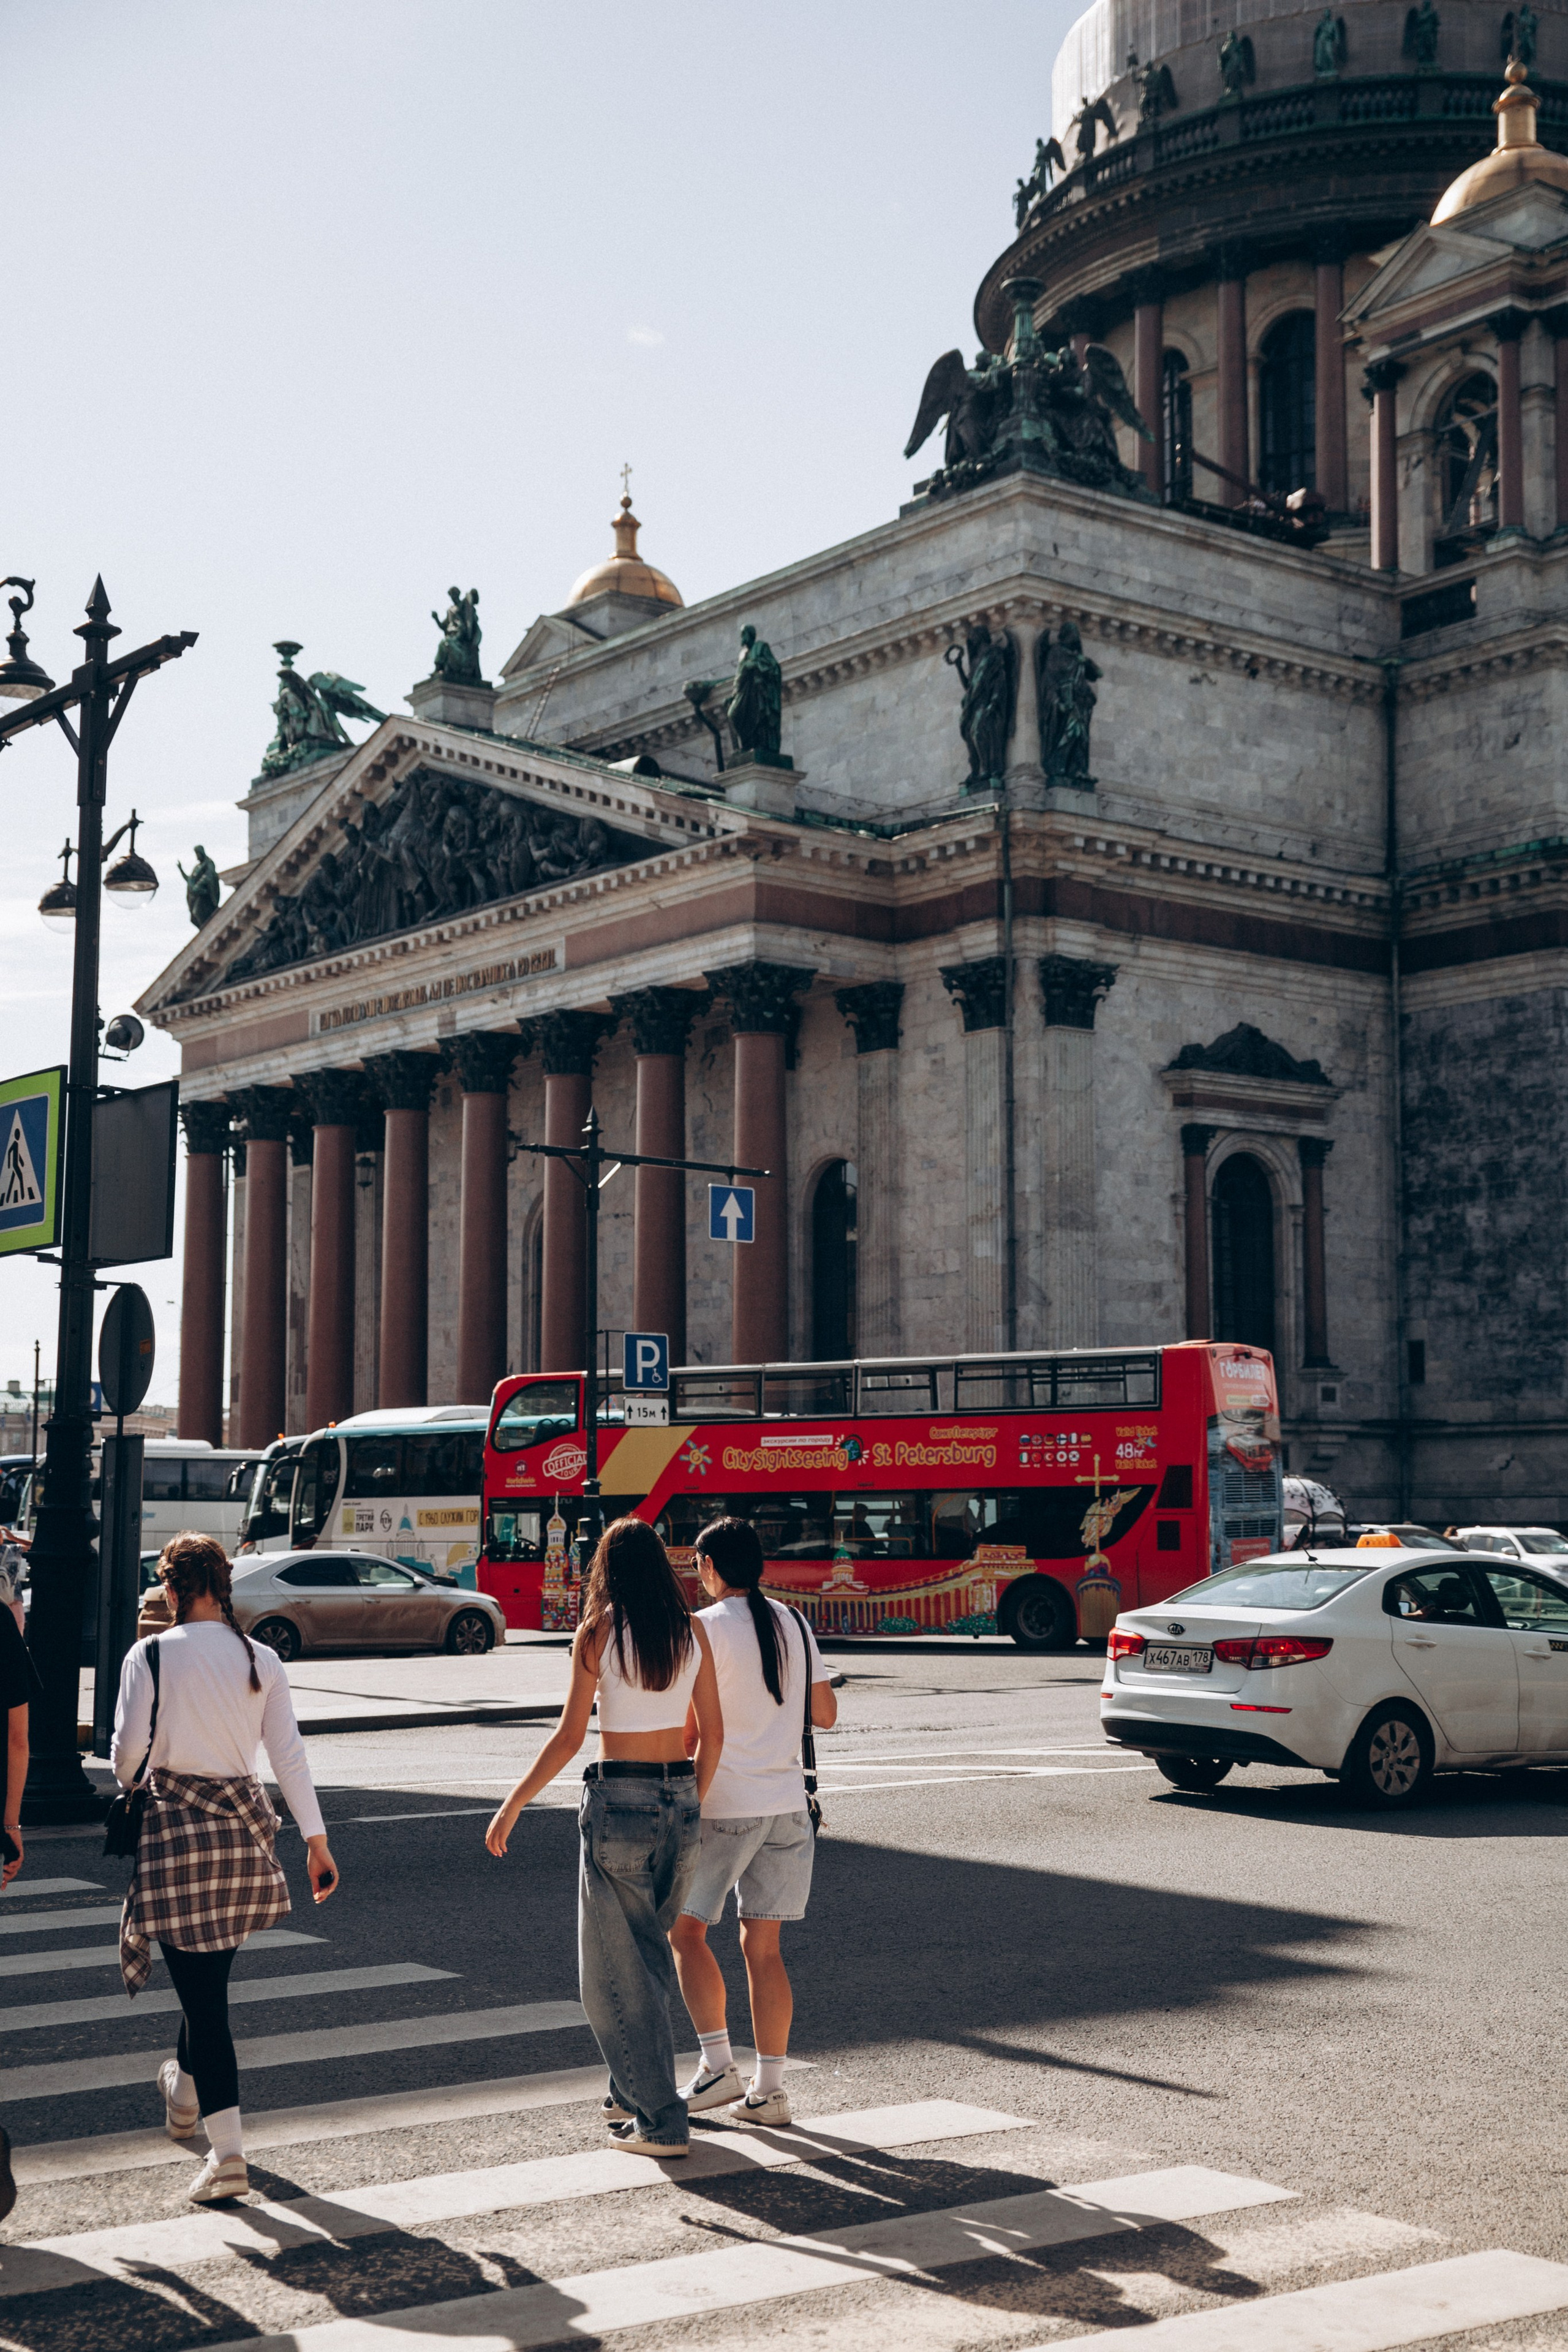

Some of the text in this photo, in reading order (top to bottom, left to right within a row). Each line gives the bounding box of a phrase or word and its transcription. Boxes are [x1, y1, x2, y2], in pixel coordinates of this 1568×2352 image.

[636, 1340, 660, 1383] P
[1219, 1360, 1265, 1381] ГОРБИЛЕТ
[872, 1441, 997, 1468] St Petersburg
[1115, 1442, 1145, 1459] 48hr
[548, 1454, 586, 1472] OFFICIAL
[723, 1446, 848, 1472] CitySightseeing
[560, 1466, 579, 1477] TOUR
[356, 1512, 374, 1521] ТРЕТИЙ
[425, 1512, 438, 1525] 1960
[356, 1523, 374, 1532] ПАРК
[1169, 1624, 1183, 1634] KIA
[1193, 1651, 1209, 1663] 178
